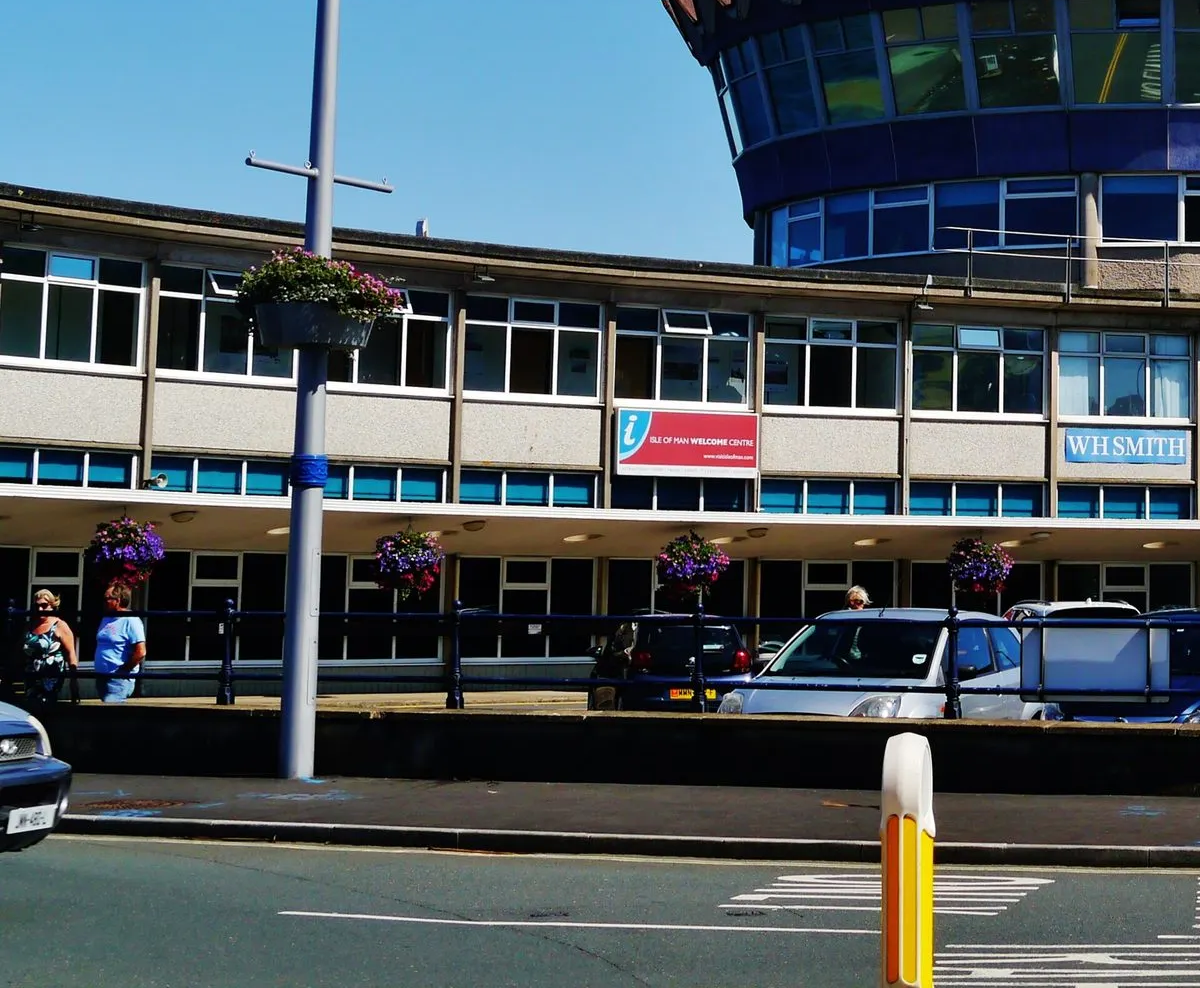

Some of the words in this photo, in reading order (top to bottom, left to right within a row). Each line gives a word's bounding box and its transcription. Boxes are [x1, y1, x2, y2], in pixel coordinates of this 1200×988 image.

[649, 436, 663, 444] ISLE
[663, 436, 673, 444] OF
[673, 437, 690, 445] MAN
[690, 437, 728, 446] WELCOME
[728, 439, 754, 447] CENTRE
[1112, 436, 1186, 457] SMITH
[717, 873, 1057, 916] ONLY
